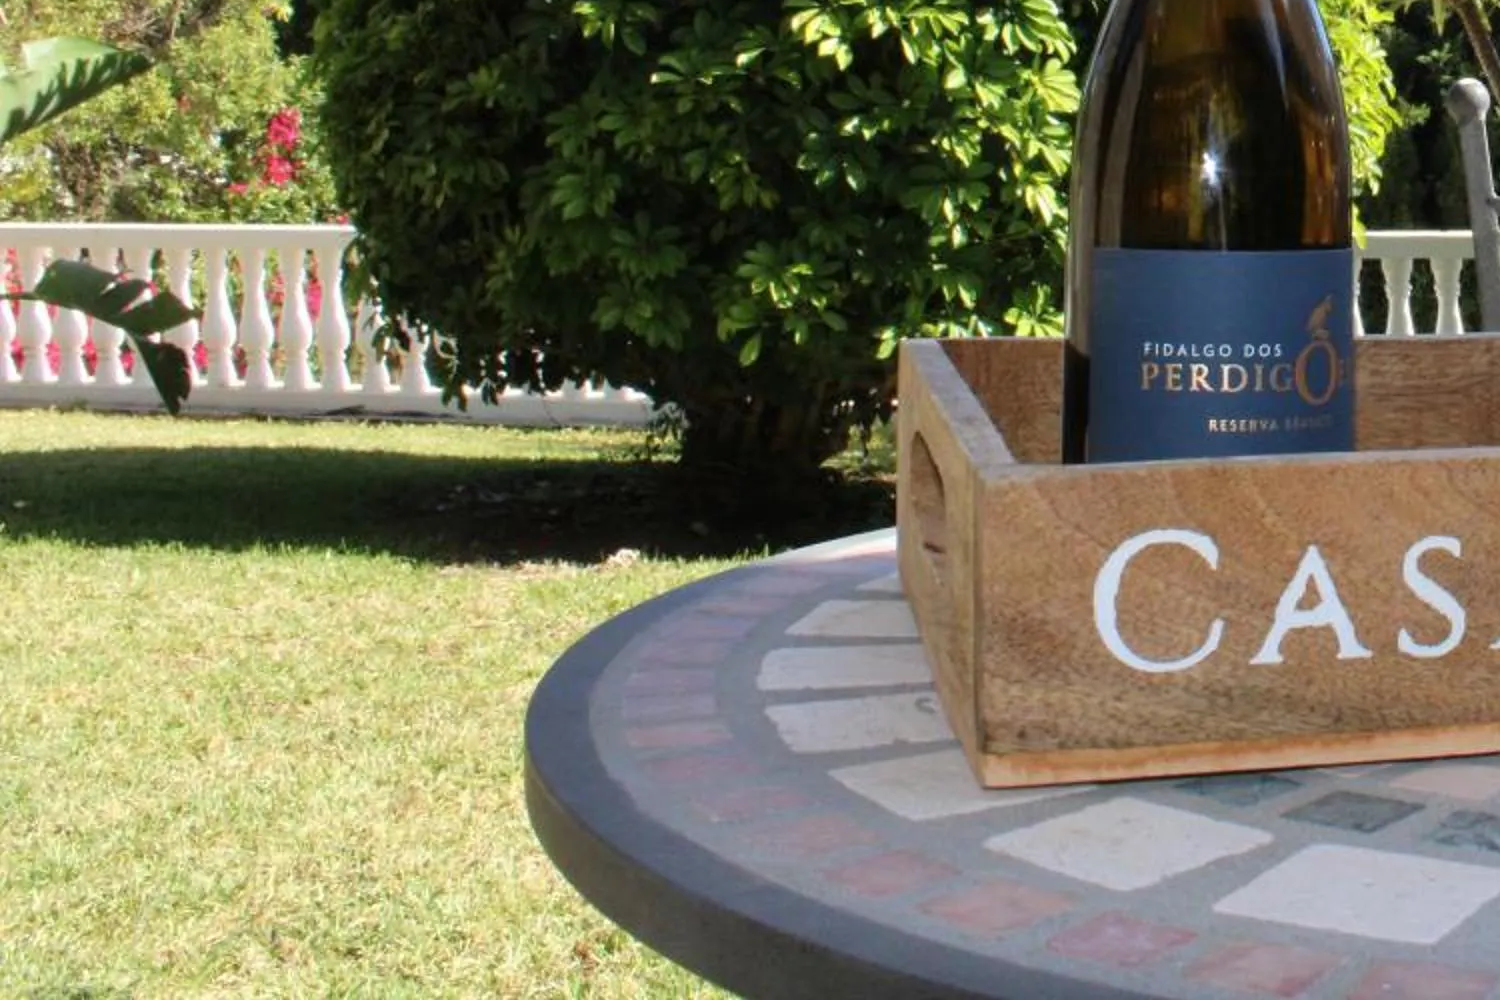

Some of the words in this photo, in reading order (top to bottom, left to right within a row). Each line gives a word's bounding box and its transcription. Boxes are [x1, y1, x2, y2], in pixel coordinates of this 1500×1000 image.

[1143, 342, 1233, 358] FIDALGO
[1244, 342, 1283, 358] DOS
[1208, 418, 1279, 433] RESERVA
